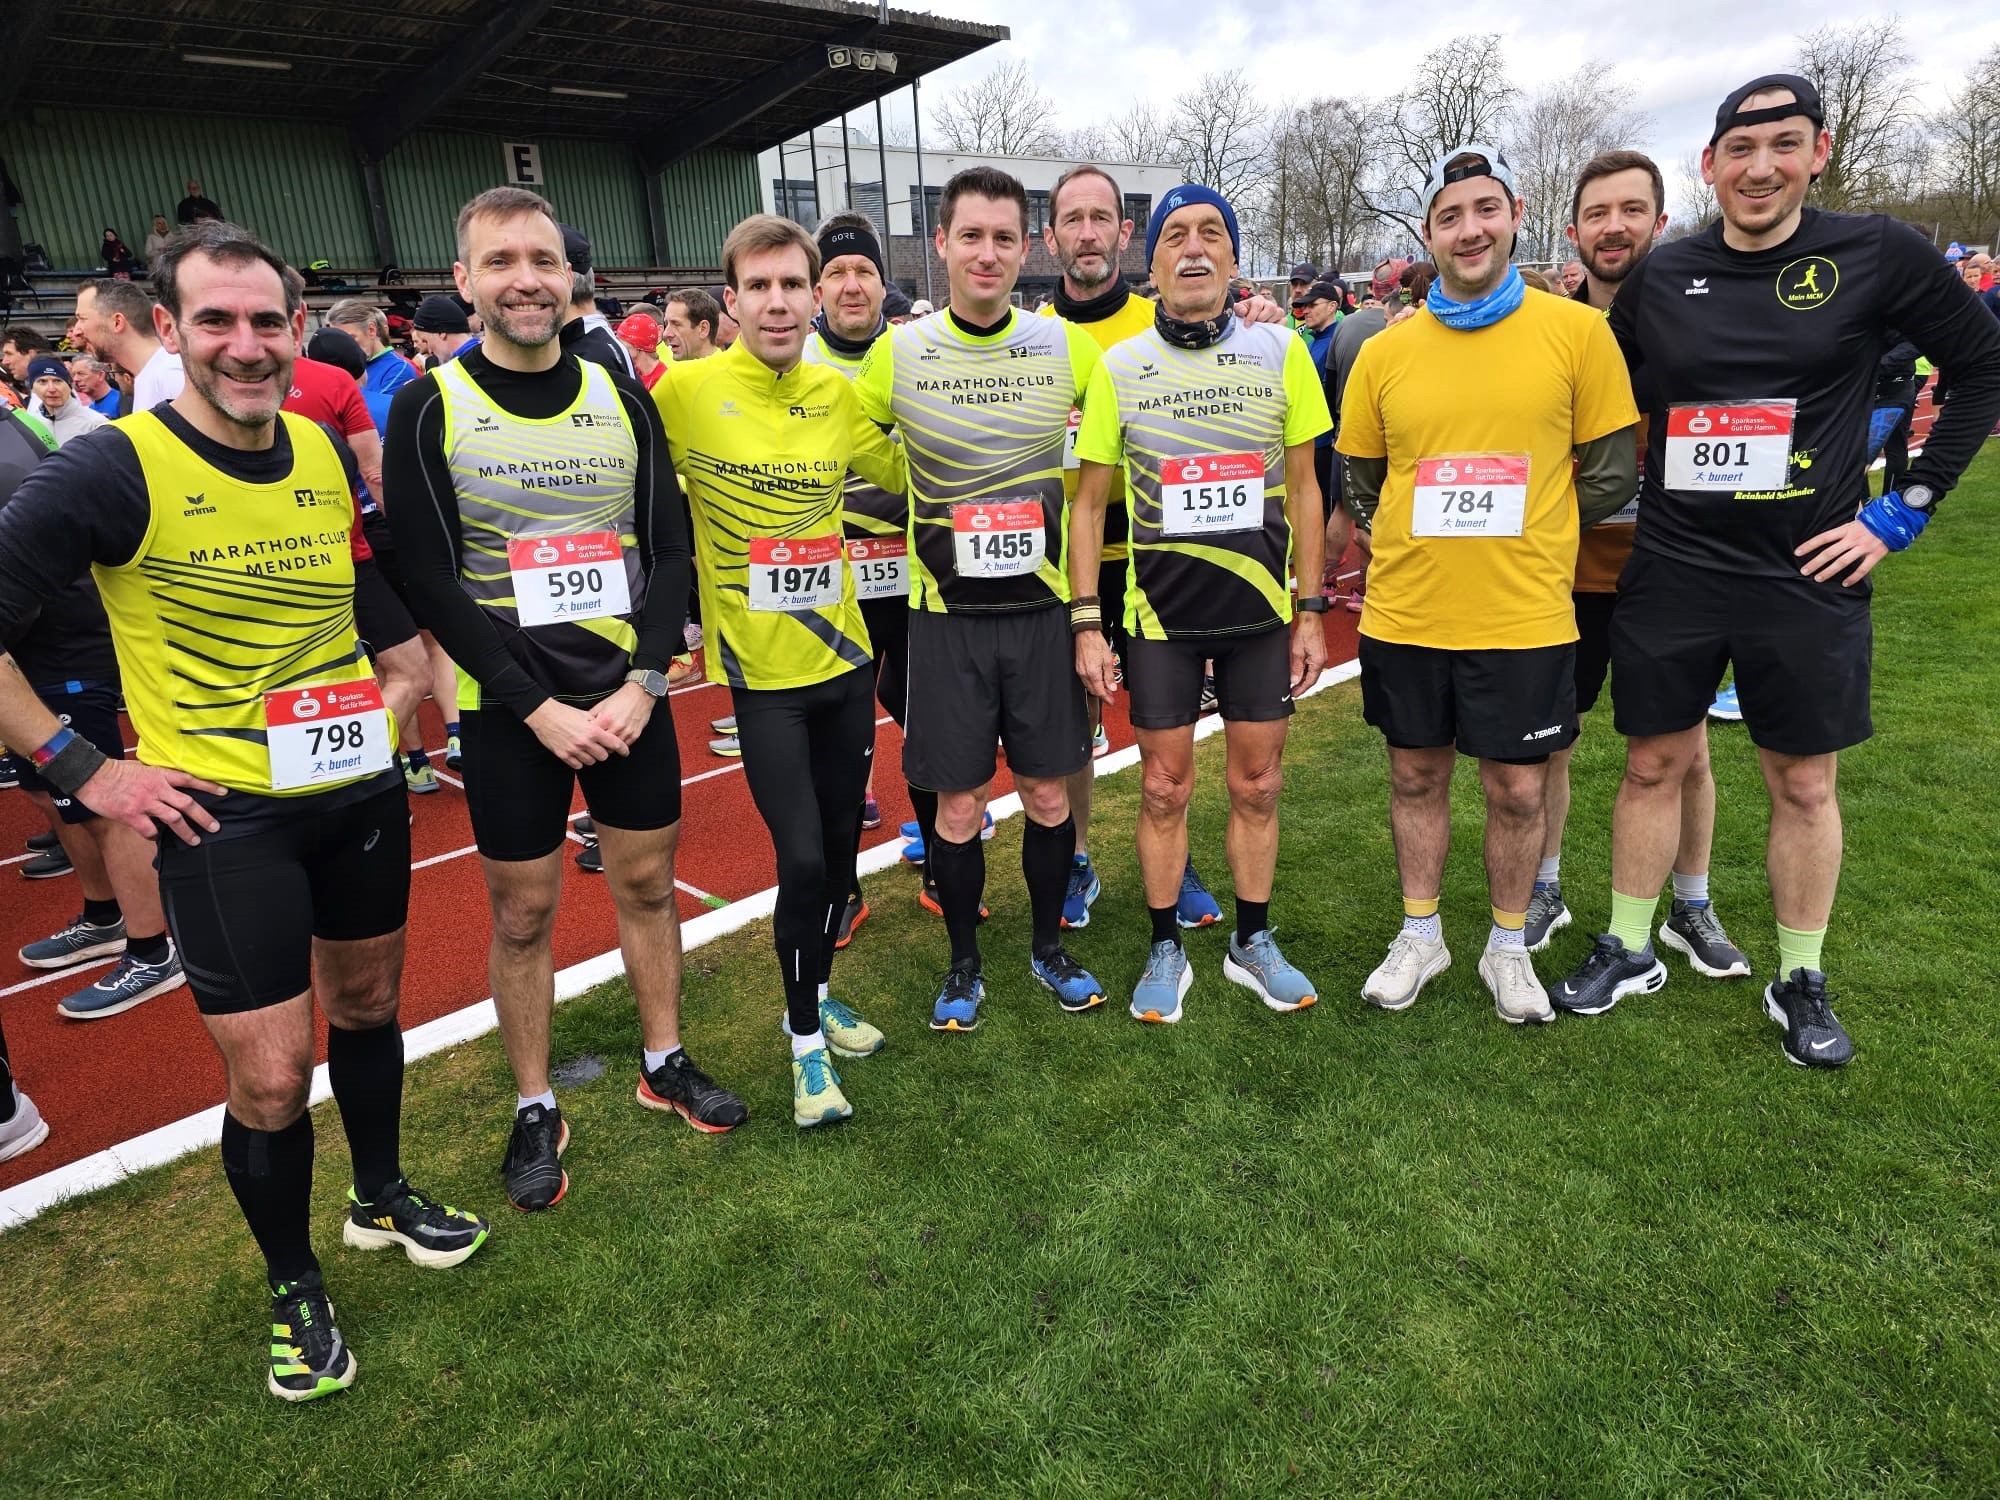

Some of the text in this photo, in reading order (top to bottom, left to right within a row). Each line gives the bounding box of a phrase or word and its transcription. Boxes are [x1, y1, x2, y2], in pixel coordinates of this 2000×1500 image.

[513, 146, 534, 182] E
[832, 233, 855, 242] GORE
[1139, 370, 1159, 380] erima
[917, 376, 1054, 391] MARATHON-CLUB
[952, 392, 1022, 405] MENDEN
[1139, 386, 1273, 411] MARATHON-CLUB
[1173, 402, 1244, 419] MENDEN
[1693, 442, 1749, 467] 801
[479, 457, 625, 478] MARATHON-CLUB
[715, 461, 838, 475] MARATHON-CLUB
[521, 473, 597, 490] MENDEN
[1708, 472, 1744, 482] bunert
[752, 478, 820, 492] MENDEN
[318, 498, 331, 506] Bank
[1182, 485, 1247, 511] 1516
[1441, 490, 1494, 513] 784
[1734, 491, 1776, 500] Reinhold
[184, 506, 217, 516] erima
[1206, 513, 1234, 524] bunert
[1455, 519, 1487, 528] bunert
[189, 531, 347, 563] MARATHON-CLUB
[969, 532, 1033, 560] 1455
[246, 553, 332, 576] MENDEN
[994, 561, 1020, 571] bunert
[767, 565, 830, 593] 1974
[860, 562, 899, 582] 155
[548, 568, 603, 598] 590
[874, 583, 897, 593] bunert
[571, 598, 601, 612] bunert
[792, 595, 817, 604] bunert
[339, 693, 364, 703] Sparkasse.
[340, 702, 349, 710] Gut
[350, 701, 359, 709] für
[306, 720, 364, 756] 798
[1534, 725, 1562, 739] TERREX
[329, 754, 362, 771] bunert
